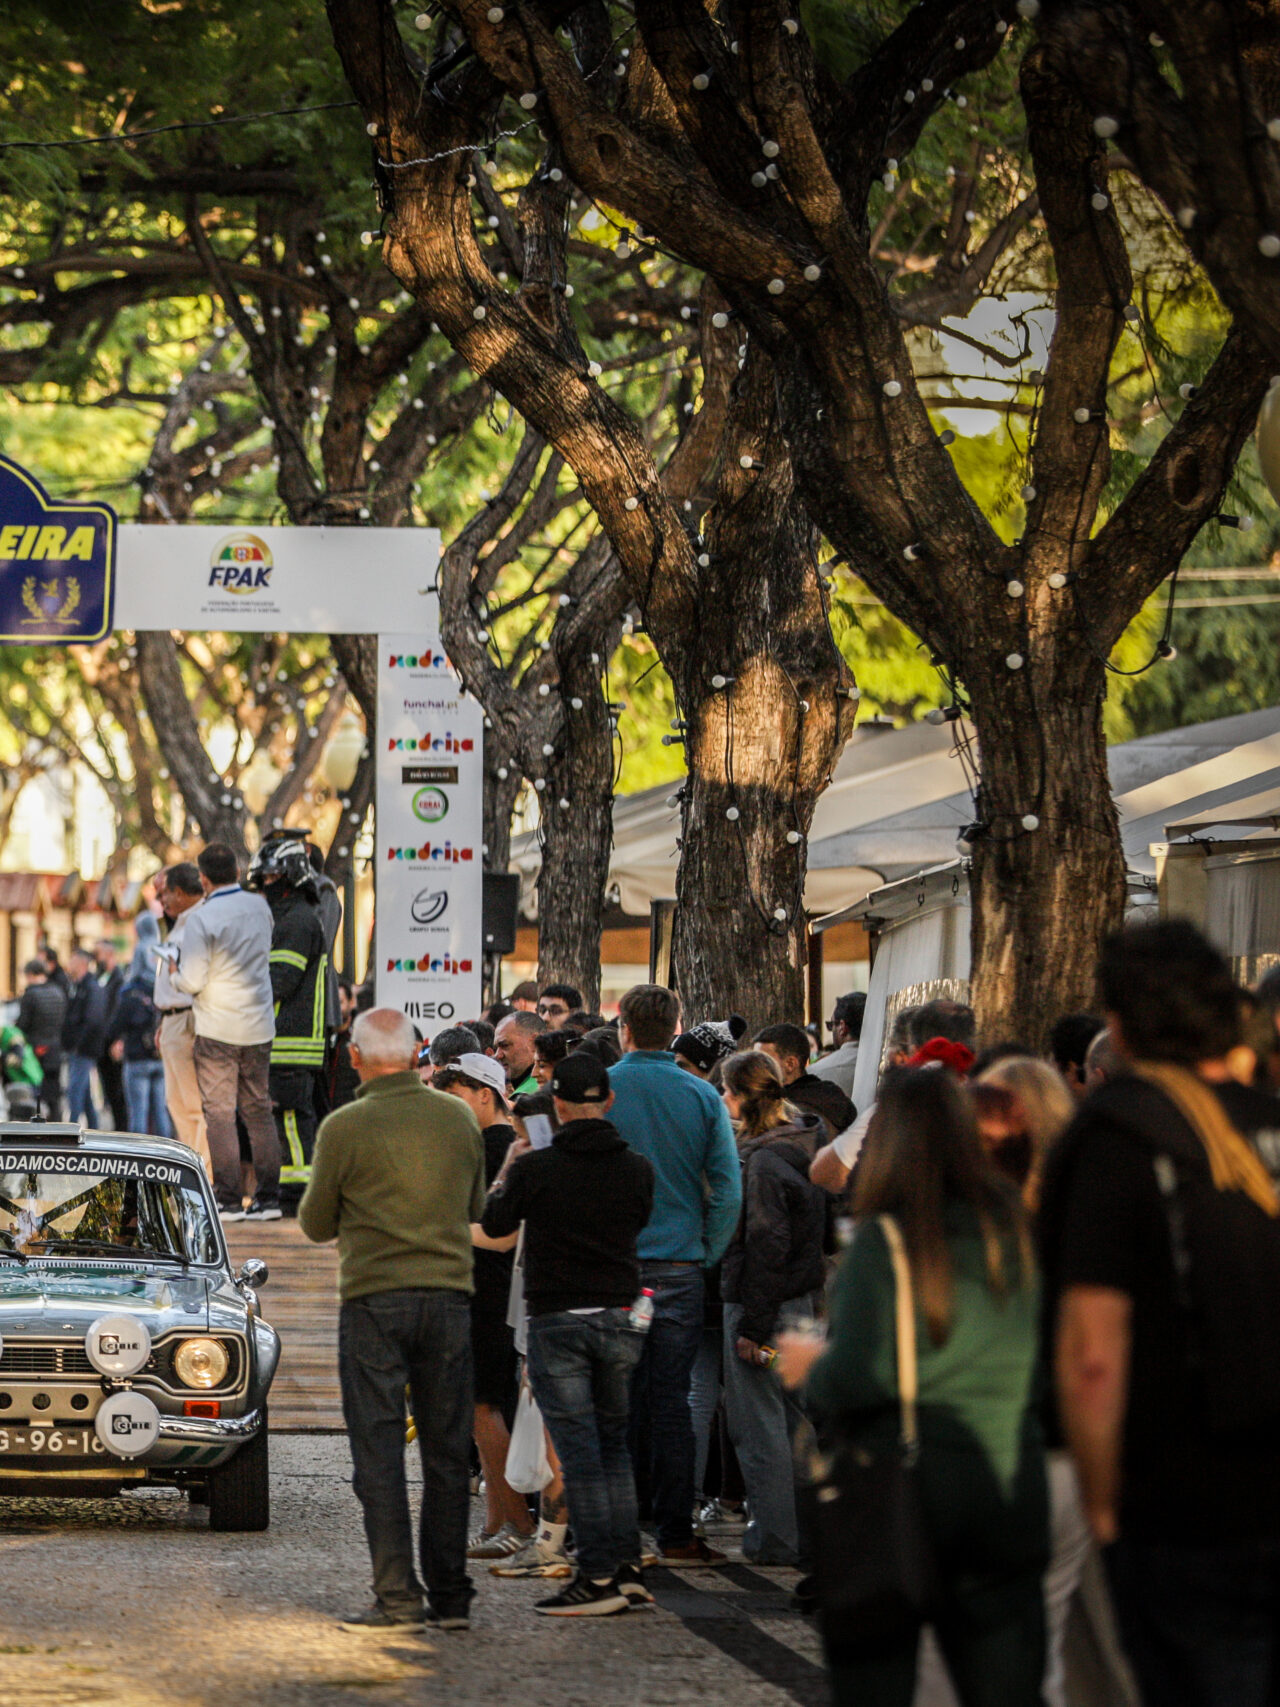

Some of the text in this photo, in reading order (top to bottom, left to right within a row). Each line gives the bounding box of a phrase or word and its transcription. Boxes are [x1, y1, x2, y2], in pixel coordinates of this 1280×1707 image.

[208, 566, 273, 587] FPAK
[388, 731, 474, 754] madeira
[387, 840, 473, 863] madeira
[387, 952, 472, 975] madeira
[404, 1002, 455, 1019] MEO
